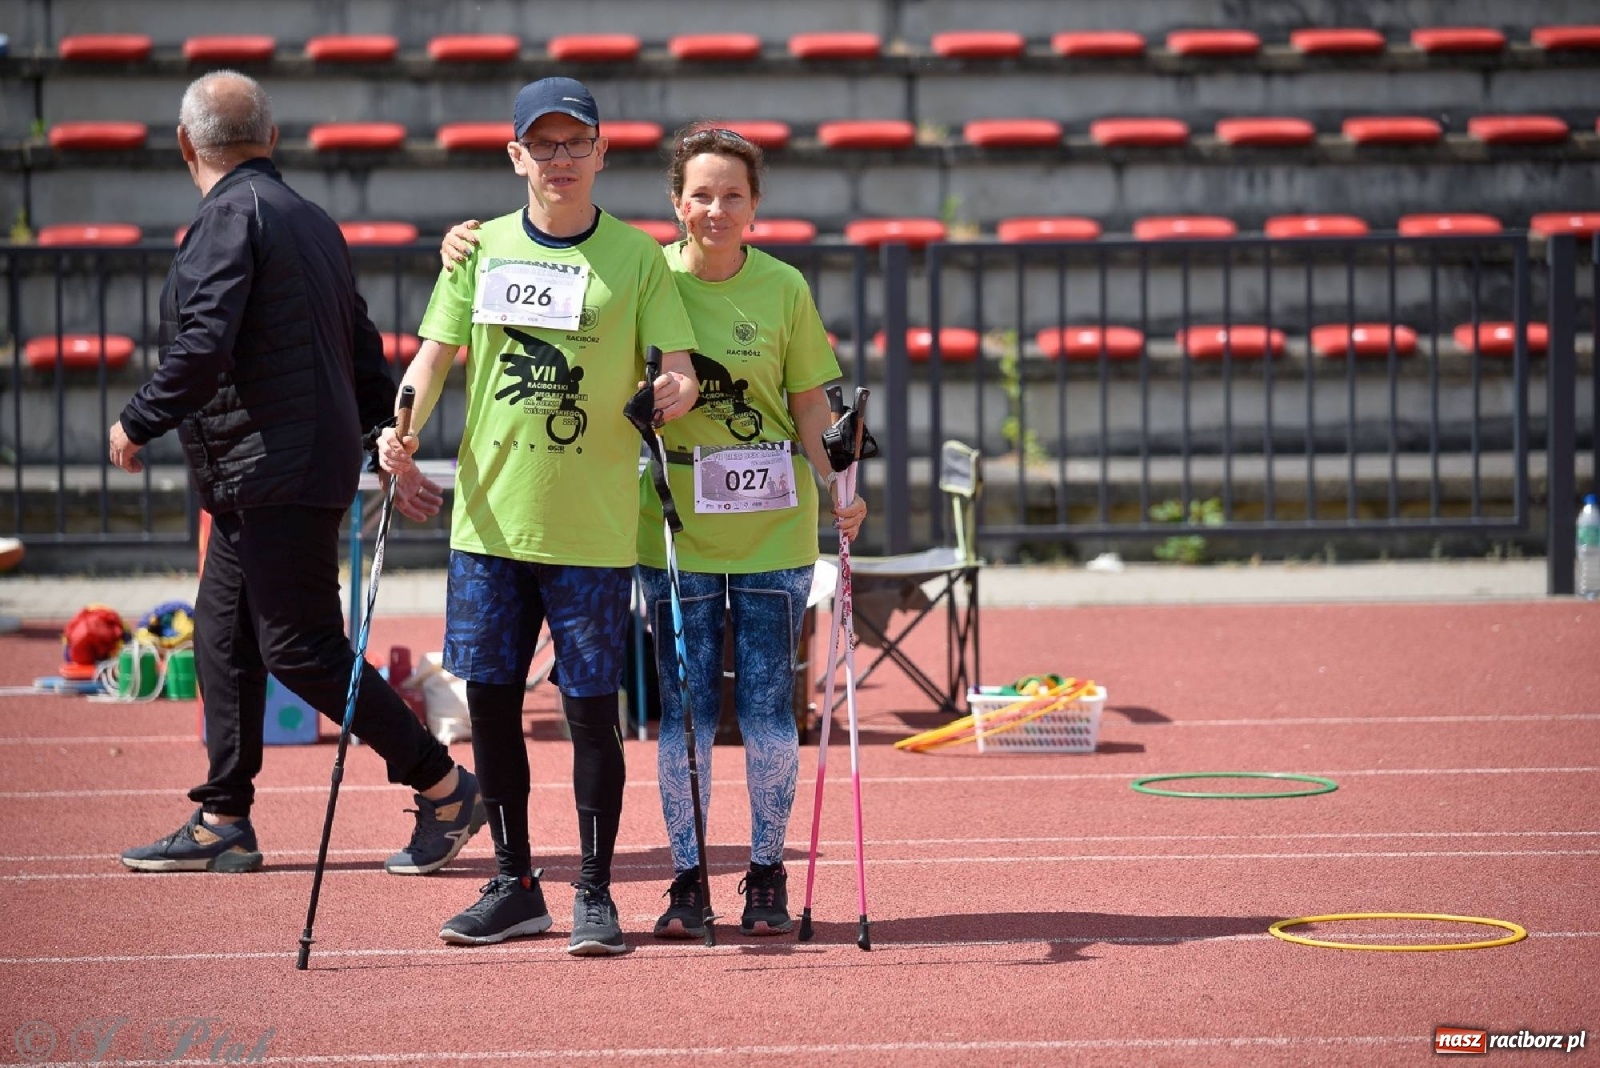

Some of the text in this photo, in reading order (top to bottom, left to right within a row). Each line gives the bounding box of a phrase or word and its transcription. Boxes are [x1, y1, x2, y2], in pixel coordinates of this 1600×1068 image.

[506, 283, 552, 306] 026
[530, 365, 557, 382] VII
[725, 468, 769, 491] 027
